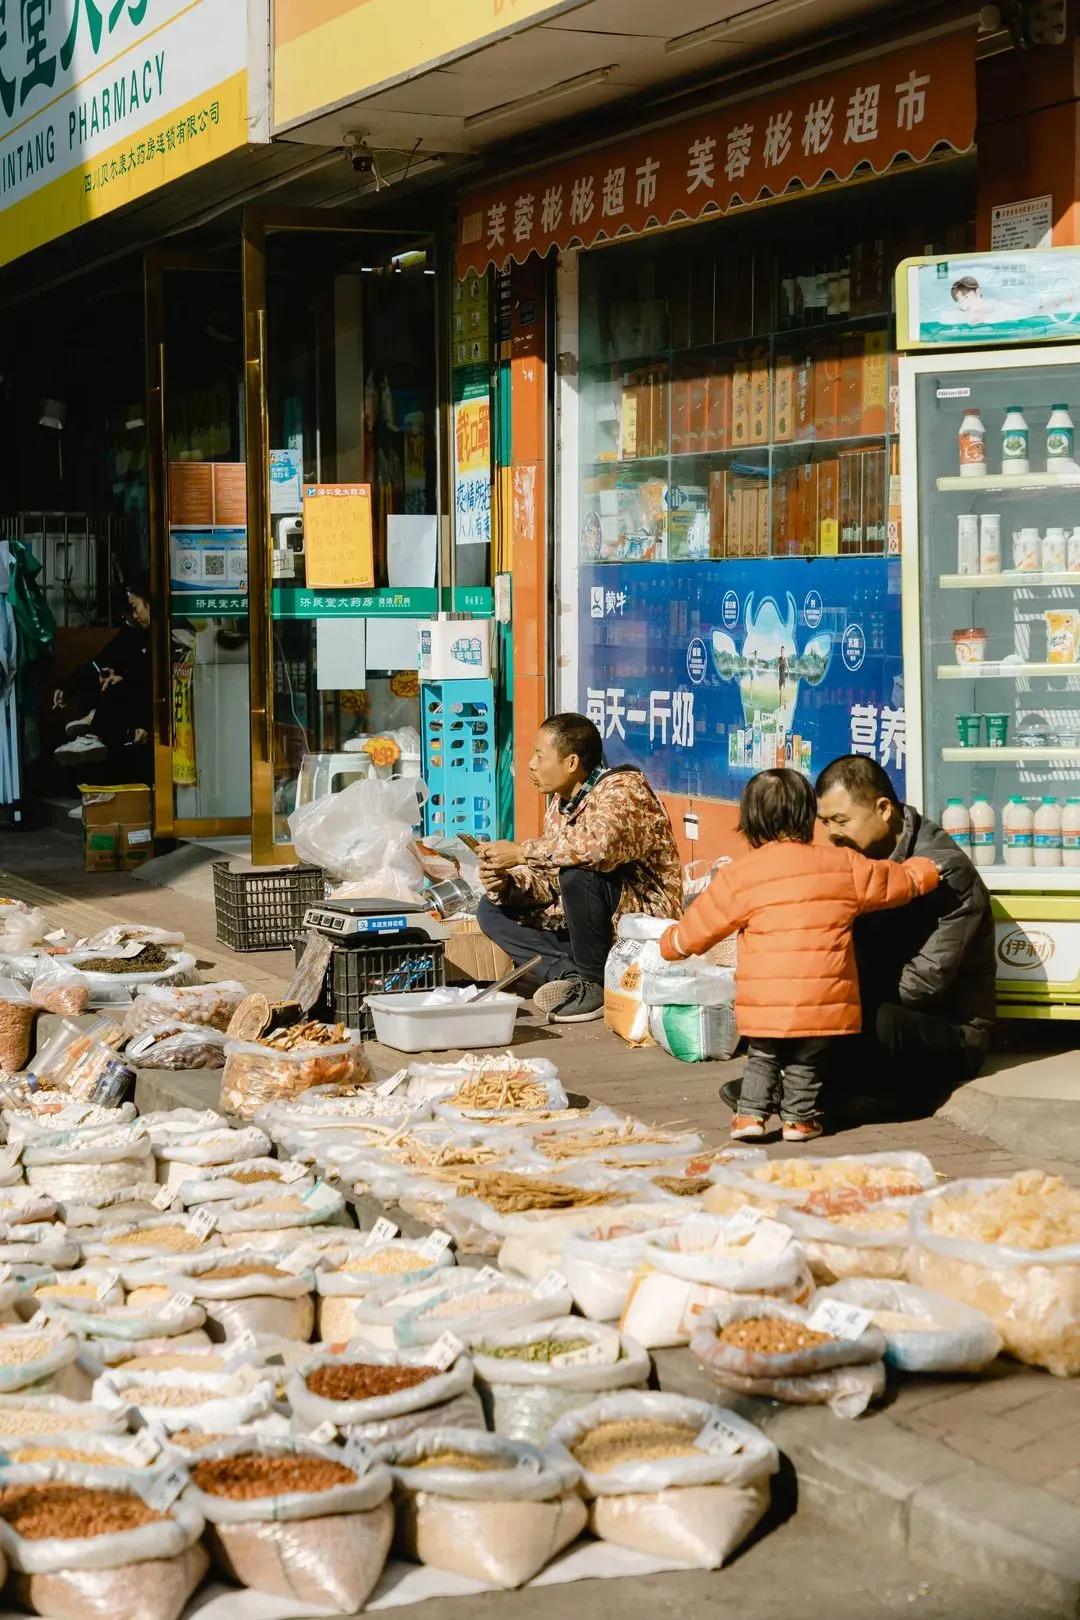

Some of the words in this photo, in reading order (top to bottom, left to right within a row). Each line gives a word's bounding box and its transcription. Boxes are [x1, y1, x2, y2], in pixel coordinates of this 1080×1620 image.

[69, 50, 165, 150] PHARMACY
[486, 156, 661, 251] 芙蓉彬彬超市
[686, 69, 931, 194] 芙蓉彬彬超市
[300, 597, 374, 608] 济民堂大药房
[586, 686, 694, 747] 每天一斤奶
[850, 703, 906, 770] 营养
[1004, 939, 1047, 958] 伊利
